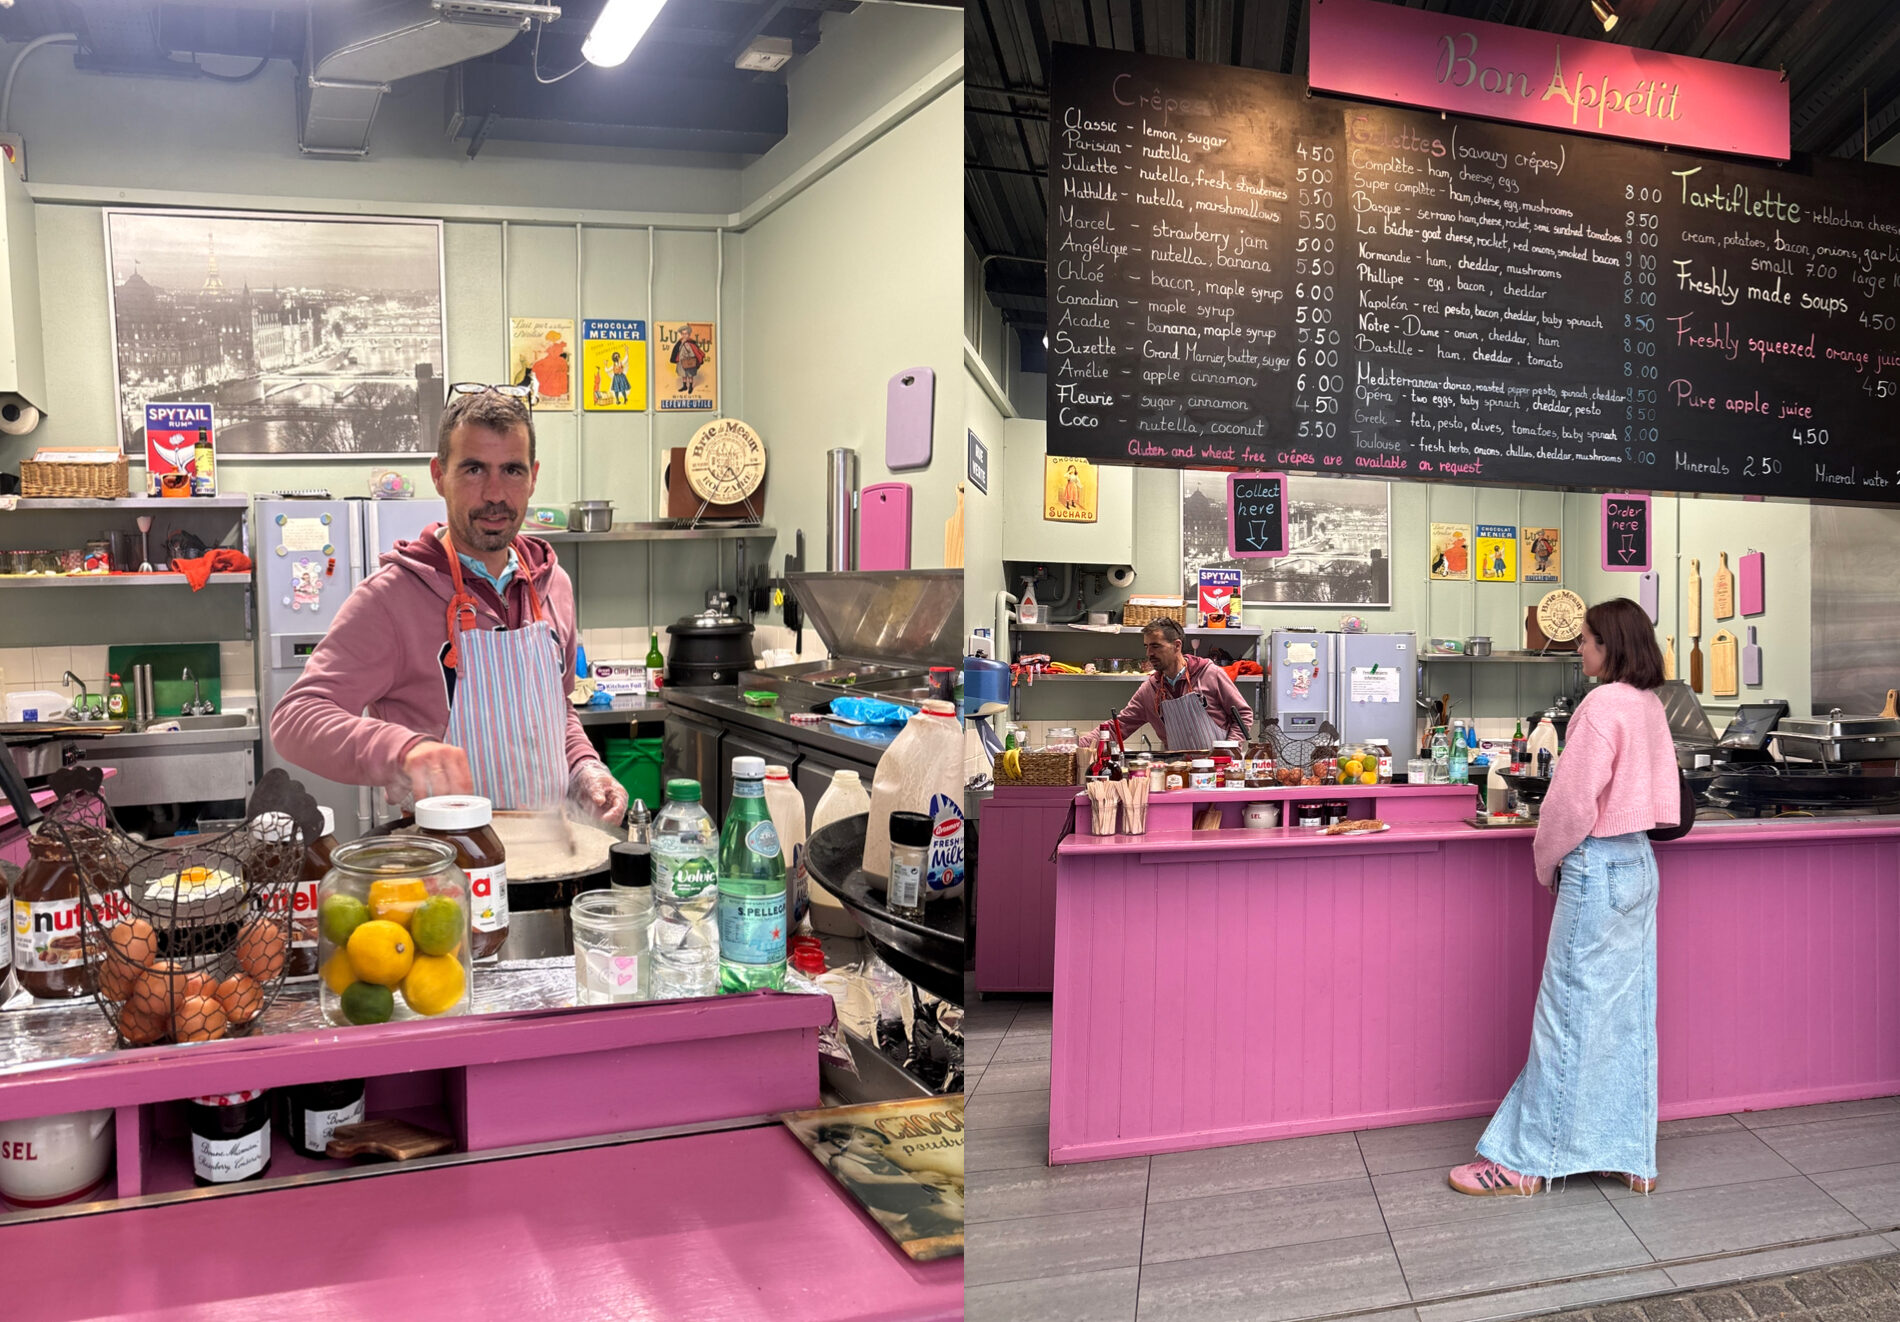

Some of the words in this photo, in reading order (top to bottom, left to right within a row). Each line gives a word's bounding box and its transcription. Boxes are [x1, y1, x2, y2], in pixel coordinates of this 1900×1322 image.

[1435, 32, 1535, 98] Bon
[1062, 129, 1122, 154] Parisian
[1142, 143, 1191, 164] nutella
[1064, 107, 1117, 130] Classic
[1142, 119, 1184, 144] lemon,
[1187, 132, 1227, 151] sugar
[1062, 153, 1118, 175] Juliette
[1195, 169, 1233, 191] fresh
[1352, 149, 1415, 174] Complète
[1498, 174, 1520, 194] egg
[1624, 183, 1662, 204] 8.00
[1064, 178, 1118, 202] Mathilde
[1195, 195, 1281, 223] marshmallows
[1298, 211, 1336, 232] 5.50
[1352, 190, 1402, 226] Basque
[1416, 205, 1456, 222] serrano
[1353, 172, 1390, 193] Super
[1394, 180, 1436, 197] complète
[1522, 199, 1574, 218] mushrooms
[1625, 210, 1659, 230] 8.50
[1671, 166, 1801, 224] Tartiflette
[1059, 204, 1116, 231] Marcel
[1153, 220, 1230, 251] strawberry
[1235, 230, 1269, 256] jam
[1356, 214, 1378, 235] La
[1421, 224, 1442, 243] goat
[1513, 241, 1529, 253] red
[1592, 248, 1621, 267] bacon
[1060, 231, 1129, 262] Angélique
[1217, 248, 1271, 272] banana
[1296, 259, 1335, 276] 5.50
[1358, 241, 1412, 264] Normandie
[1506, 263, 1562, 279] mushrooms
[1057, 261, 1105, 283] Chloé
[1151, 270, 1202, 296] bacon,
[1206, 280, 1245, 299] maple
[1250, 287, 1284, 304] syrup
[1295, 283, 1335, 302] 6.00
[1503, 281, 1548, 299] cheddar
[1672, 259, 1739, 306] Freshly
[1747, 276, 1791, 305] made
[1800, 291, 1849, 318] soups
[1859, 310, 1896, 331] 4.50
[1750, 257, 1794, 276] small
[1806, 263, 1838, 279] 7.00
[1852, 269, 1886, 298] large
[1056, 285, 1120, 308] Canadian
[1148, 294, 1187, 315] maple
[1197, 305, 1235, 324] syrup
[1358, 289, 1409, 314] Napoléon
[1422, 300, 1440, 314] red
[1541, 310, 1563, 329] baby
[589, 330, 640, 340] MENIER
[591, 322, 638, 330] CHOCOLAT
[659, 325, 678, 343] LU
[1058, 309, 1110, 329] Acadie
[1147, 316, 1202, 339] banana,
[1203, 322, 1242, 342] maple
[1246, 328, 1277, 344] syrup
[1297, 328, 1341, 345] 5.50
[1358, 312, 1390, 334] Notre
[1538, 330, 1561, 348] ham
[1054, 331, 1117, 355] Suzette
[1143, 340, 1181, 360] Grand
[1262, 356, 1290, 372] sugar
[1297, 348, 1339, 368] 6.00
[1354, 333, 1414, 356] Bastille
[1527, 354, 1564, 369] tomato
[1666, 311, 1739, 360] Freshly
[1748, 333, 1816, 363] squeezed
[1825, 346, 1869, 374] orange
[1862, 376, 1897, 399] 4.50
[1058, 358, 1109, 378] Amélie
[1143, 368, 1180, 388] apple
[1190, 371, 1257, 388] cinnamon
[1296, 373, 1344, 393] 6.00
[1056, 383, 1114, 406] Fleurie
[1187, 396, 1249, 411] cinnamon
[1295, 394, 1339, 414] 4.50
[1354, 384, 1393, 406] Opéra
[1410, 391, 1428, 405] two
[1459, 393, 1480, 411] baby
[1574, 401, 1602, 418] pesto
[1668, 378, 1716, 411] Pure
[1725, 390, 1770, 415] apple
[1777, 396, 1814, 420] juice
[149, 408, 209, 421] SPYTAIL
[1059, 407, 1099, 428] Coco
[1211, 419, 1265, 437] coconut
[1297, 420, 1337, 439] 5.50
[1354, 409, 1388, 425] Greek
[1561, 425, 1584, 443] baby
[693, 427, 717, 457] Brie
[726, 421, 759, 453] Meaux
[1350, 430, 1402, 452] Toulouse
[1418, 436, 1446, 454] fresh
[1575, 448, 1623, 464] mushrooms
[1792, 427, 1830, 446] 4.50
[1127, 439, 1169, 457] Gluten
[1171, 443, 1197, 459] and
[1201, 441, 1236, 461] wheat
[1241, 446, 1267, 464] free
[1277, 448, 1315, 466] crêpes
[1323, 455, 1344, 466] are
[1354, 454, 1408, 471] available
[1418, 459, 1434, 472] on
[1439, 457, 1484, 478] request
[1675, 450, 1730, 475] Minerals
[1743, 455, 1782, 478] 2.50
[1815, 463, 1856, 485] Mineral
[1862, 470, 1889, 487] water
[1236, 484, 1280, 499] Collect
[1237, 502, 1275, 516] here
[1049, 506, 1093, 519] SUCHARD
[1607, 502, 1644, 518] Order
[1612, 519, 1639, 532] here
[1200, 572, 1239, 582] SPYTAIL
[932, 845, 964, 869] Milk
[933, 840, 960, 849] FRESH
[677, 868, 717, 883] Volvic
[1, 1140, 38, 1162] SEL
